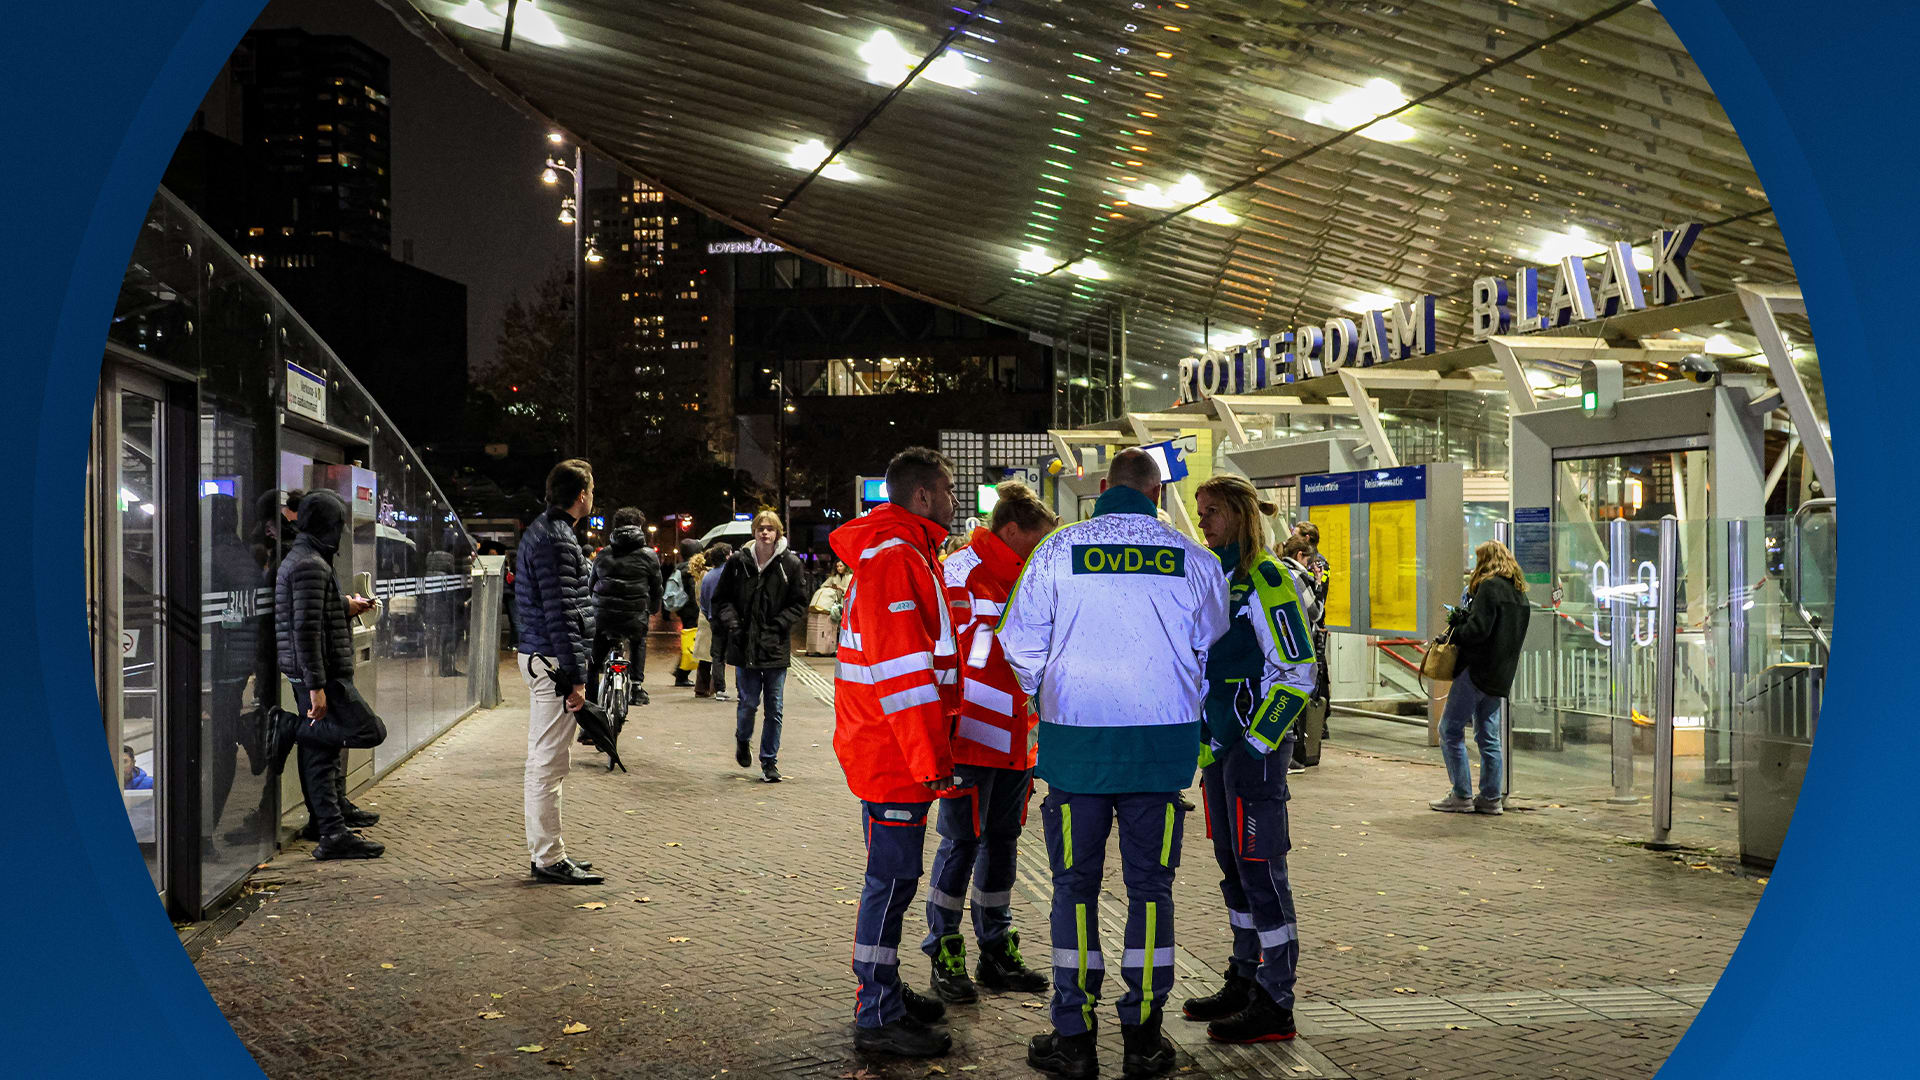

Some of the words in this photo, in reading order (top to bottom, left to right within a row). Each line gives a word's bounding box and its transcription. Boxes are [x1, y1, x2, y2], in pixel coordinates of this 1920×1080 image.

[1179, 295, 1435, 404] ROTTERDAM
[1473, 223, 1704, 342] BLAAK
[1084, 547, 1176, 573] OvD-G
[1269, 695, 1290, 723] GHOR
